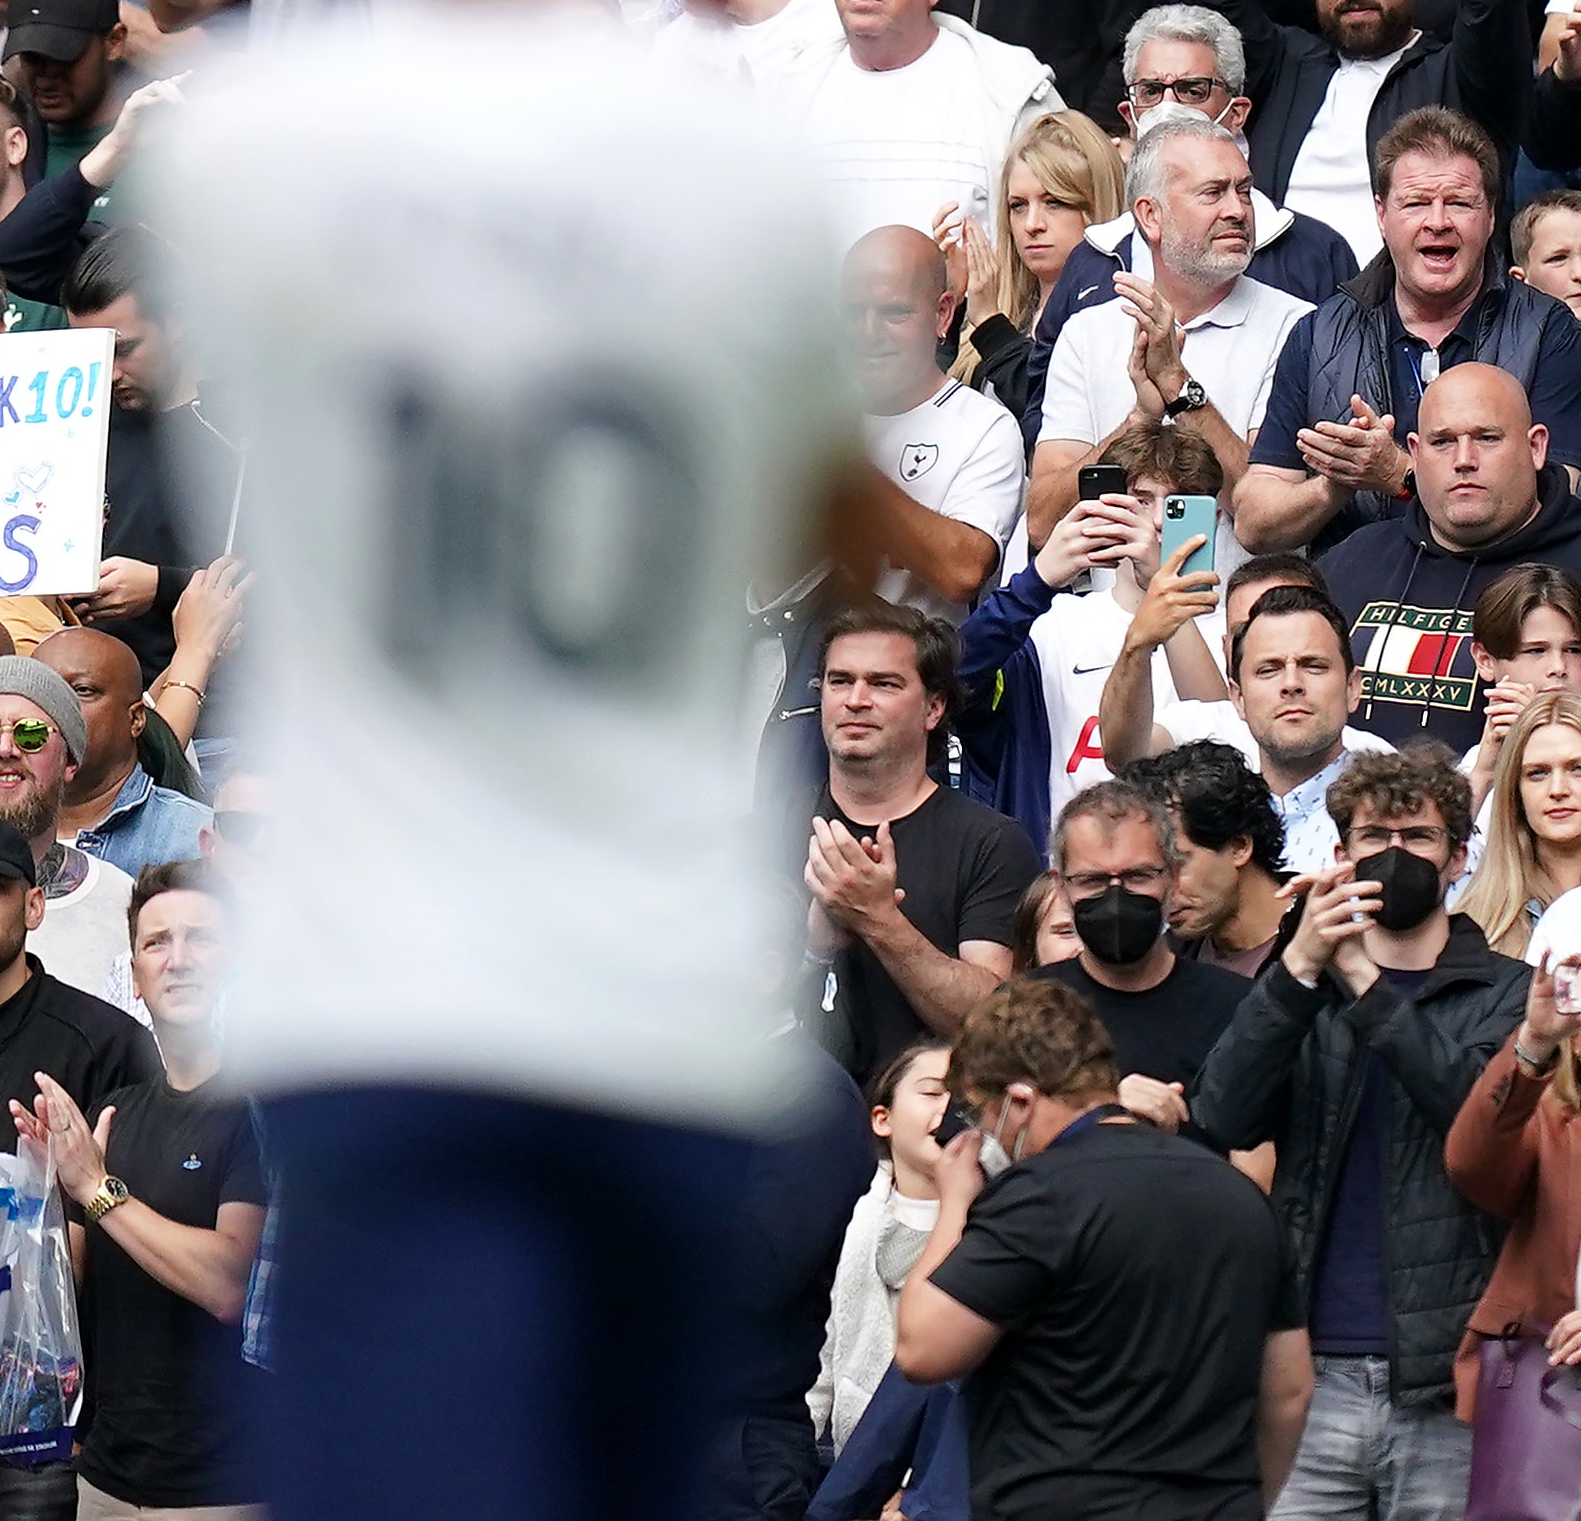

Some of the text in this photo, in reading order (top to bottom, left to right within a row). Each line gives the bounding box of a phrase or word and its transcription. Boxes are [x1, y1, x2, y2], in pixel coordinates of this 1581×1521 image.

[374, 358, 707, 670] 10
[1369, 606, 1476, 632] HILFIGE
[1359, 675, 1464, 702] CMLXXXV
